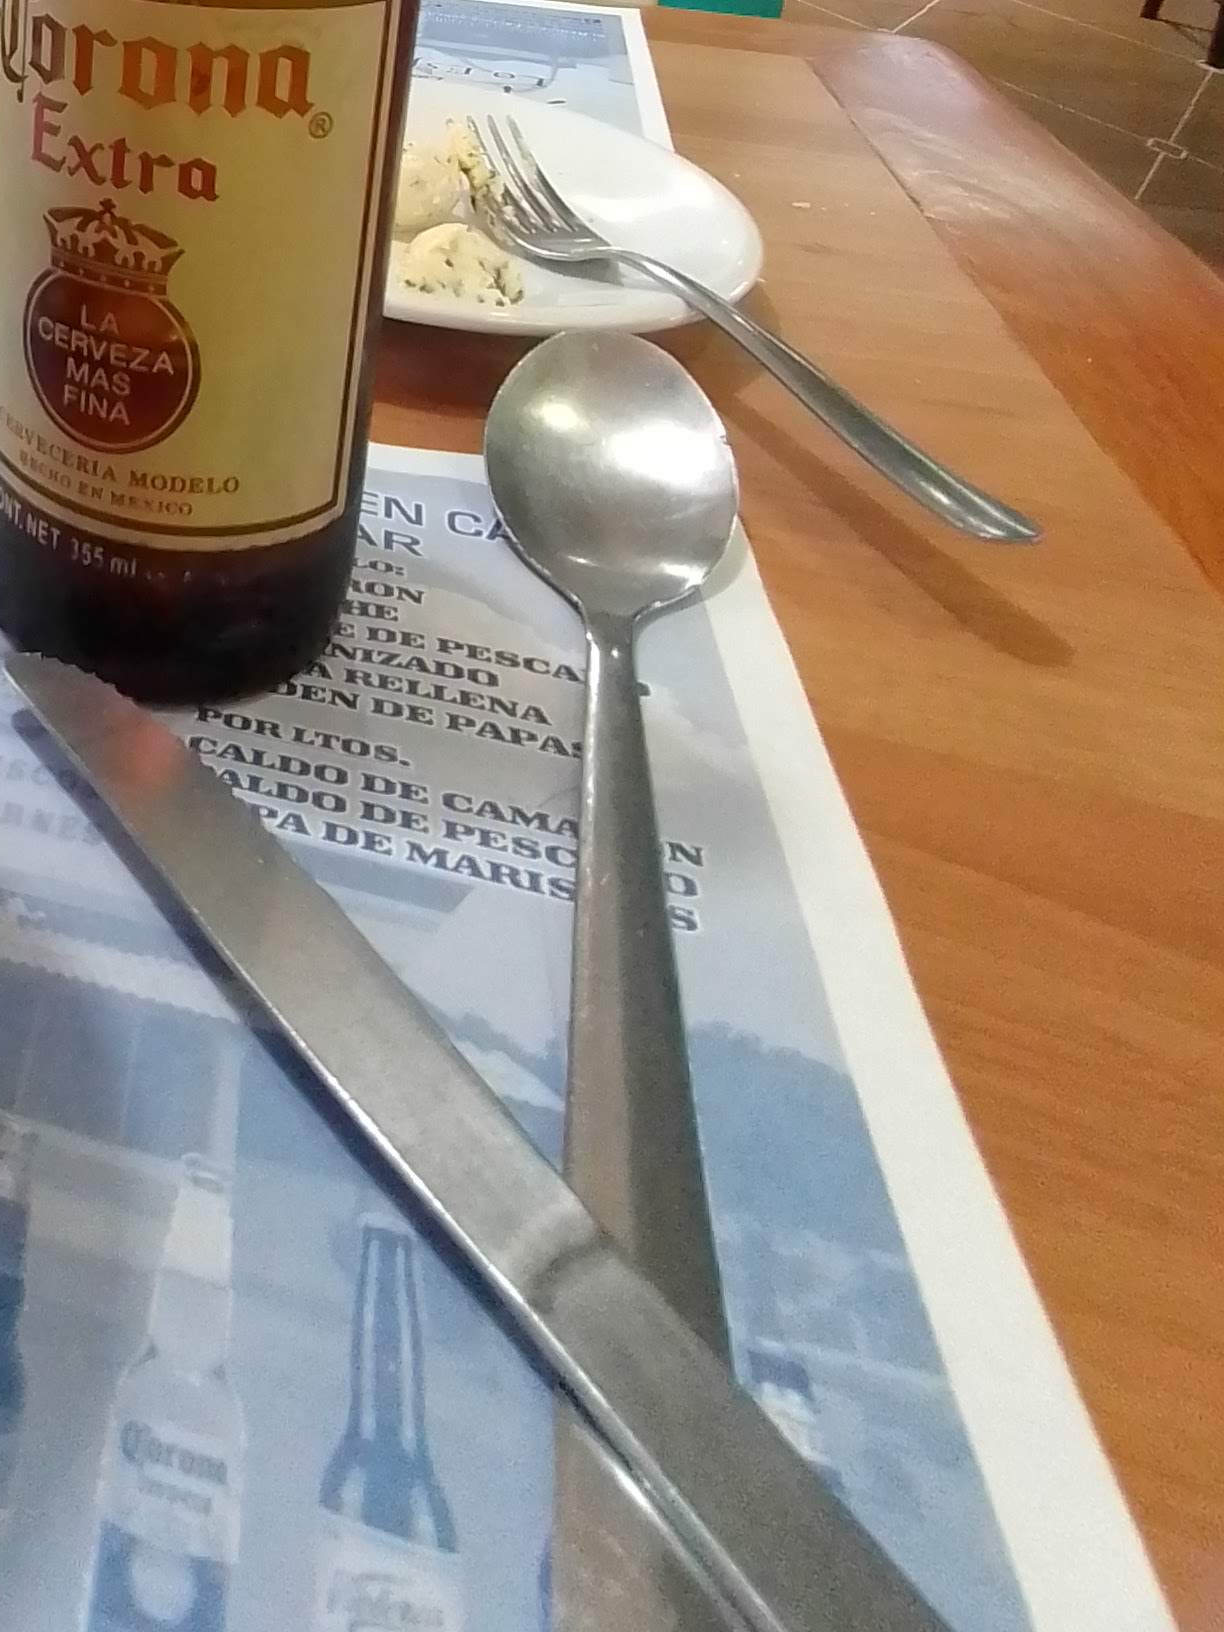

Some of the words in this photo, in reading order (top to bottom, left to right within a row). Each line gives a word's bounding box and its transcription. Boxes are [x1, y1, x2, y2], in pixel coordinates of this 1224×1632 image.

[32, 91, 219, 202] Extra
[80, 303, 119, 335] LA
[38, 316, 174, 376] CERVEZA
[66, 356, 131, 396] MAS
[63, 383, 131, 426] FINA
[78, 480, 104, 500] EN
[128, 469, 240, 495] MODELO
[447, 510, 512, 542] CA
[71, 537, 105, 567] 355
[110, 558, 137, 577] ml
[367, 626, 425, 650] DE
[325, 642, 500, 688] NIZADO
[344, 668, 552, 726] RELLENA
[371, 696, 435, 726] DE
[196, 707, 282, 739] POR
[292, 727, 412, 767] LTOS.
[189, 736, 349, 785] CALDO
[360, 772, 429, 805] DE
[441, 792, 705, 867] CAMAN
[220, 768, 348, 813] ALDO
[360, 801, 429, 834] DE
[322, 821, 393, 856] DE
[406, 840, 698, 931] MARISS
